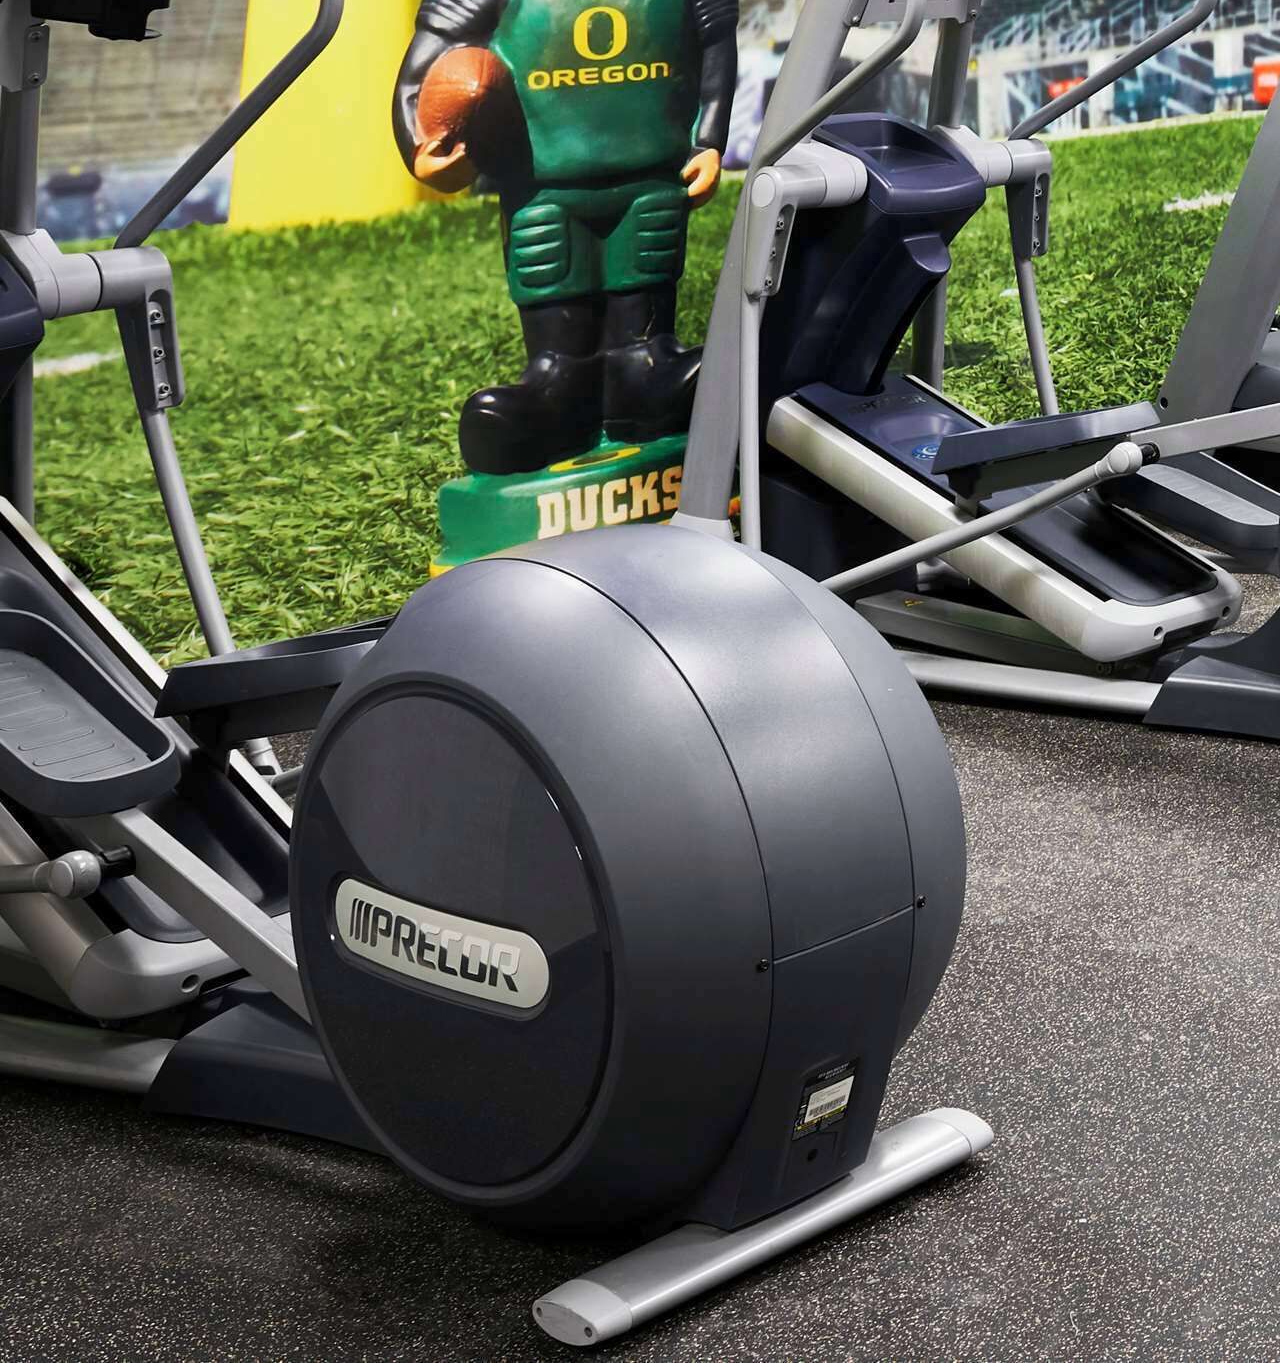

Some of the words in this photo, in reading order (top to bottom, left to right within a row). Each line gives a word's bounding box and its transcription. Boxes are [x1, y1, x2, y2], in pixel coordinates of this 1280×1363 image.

[573, 6, 628, 61] O
[527, 62, 670, 90] OREGON
[537, 465, 684, 540] DUCKS
[350, 897, 520, 992] PRECOR
